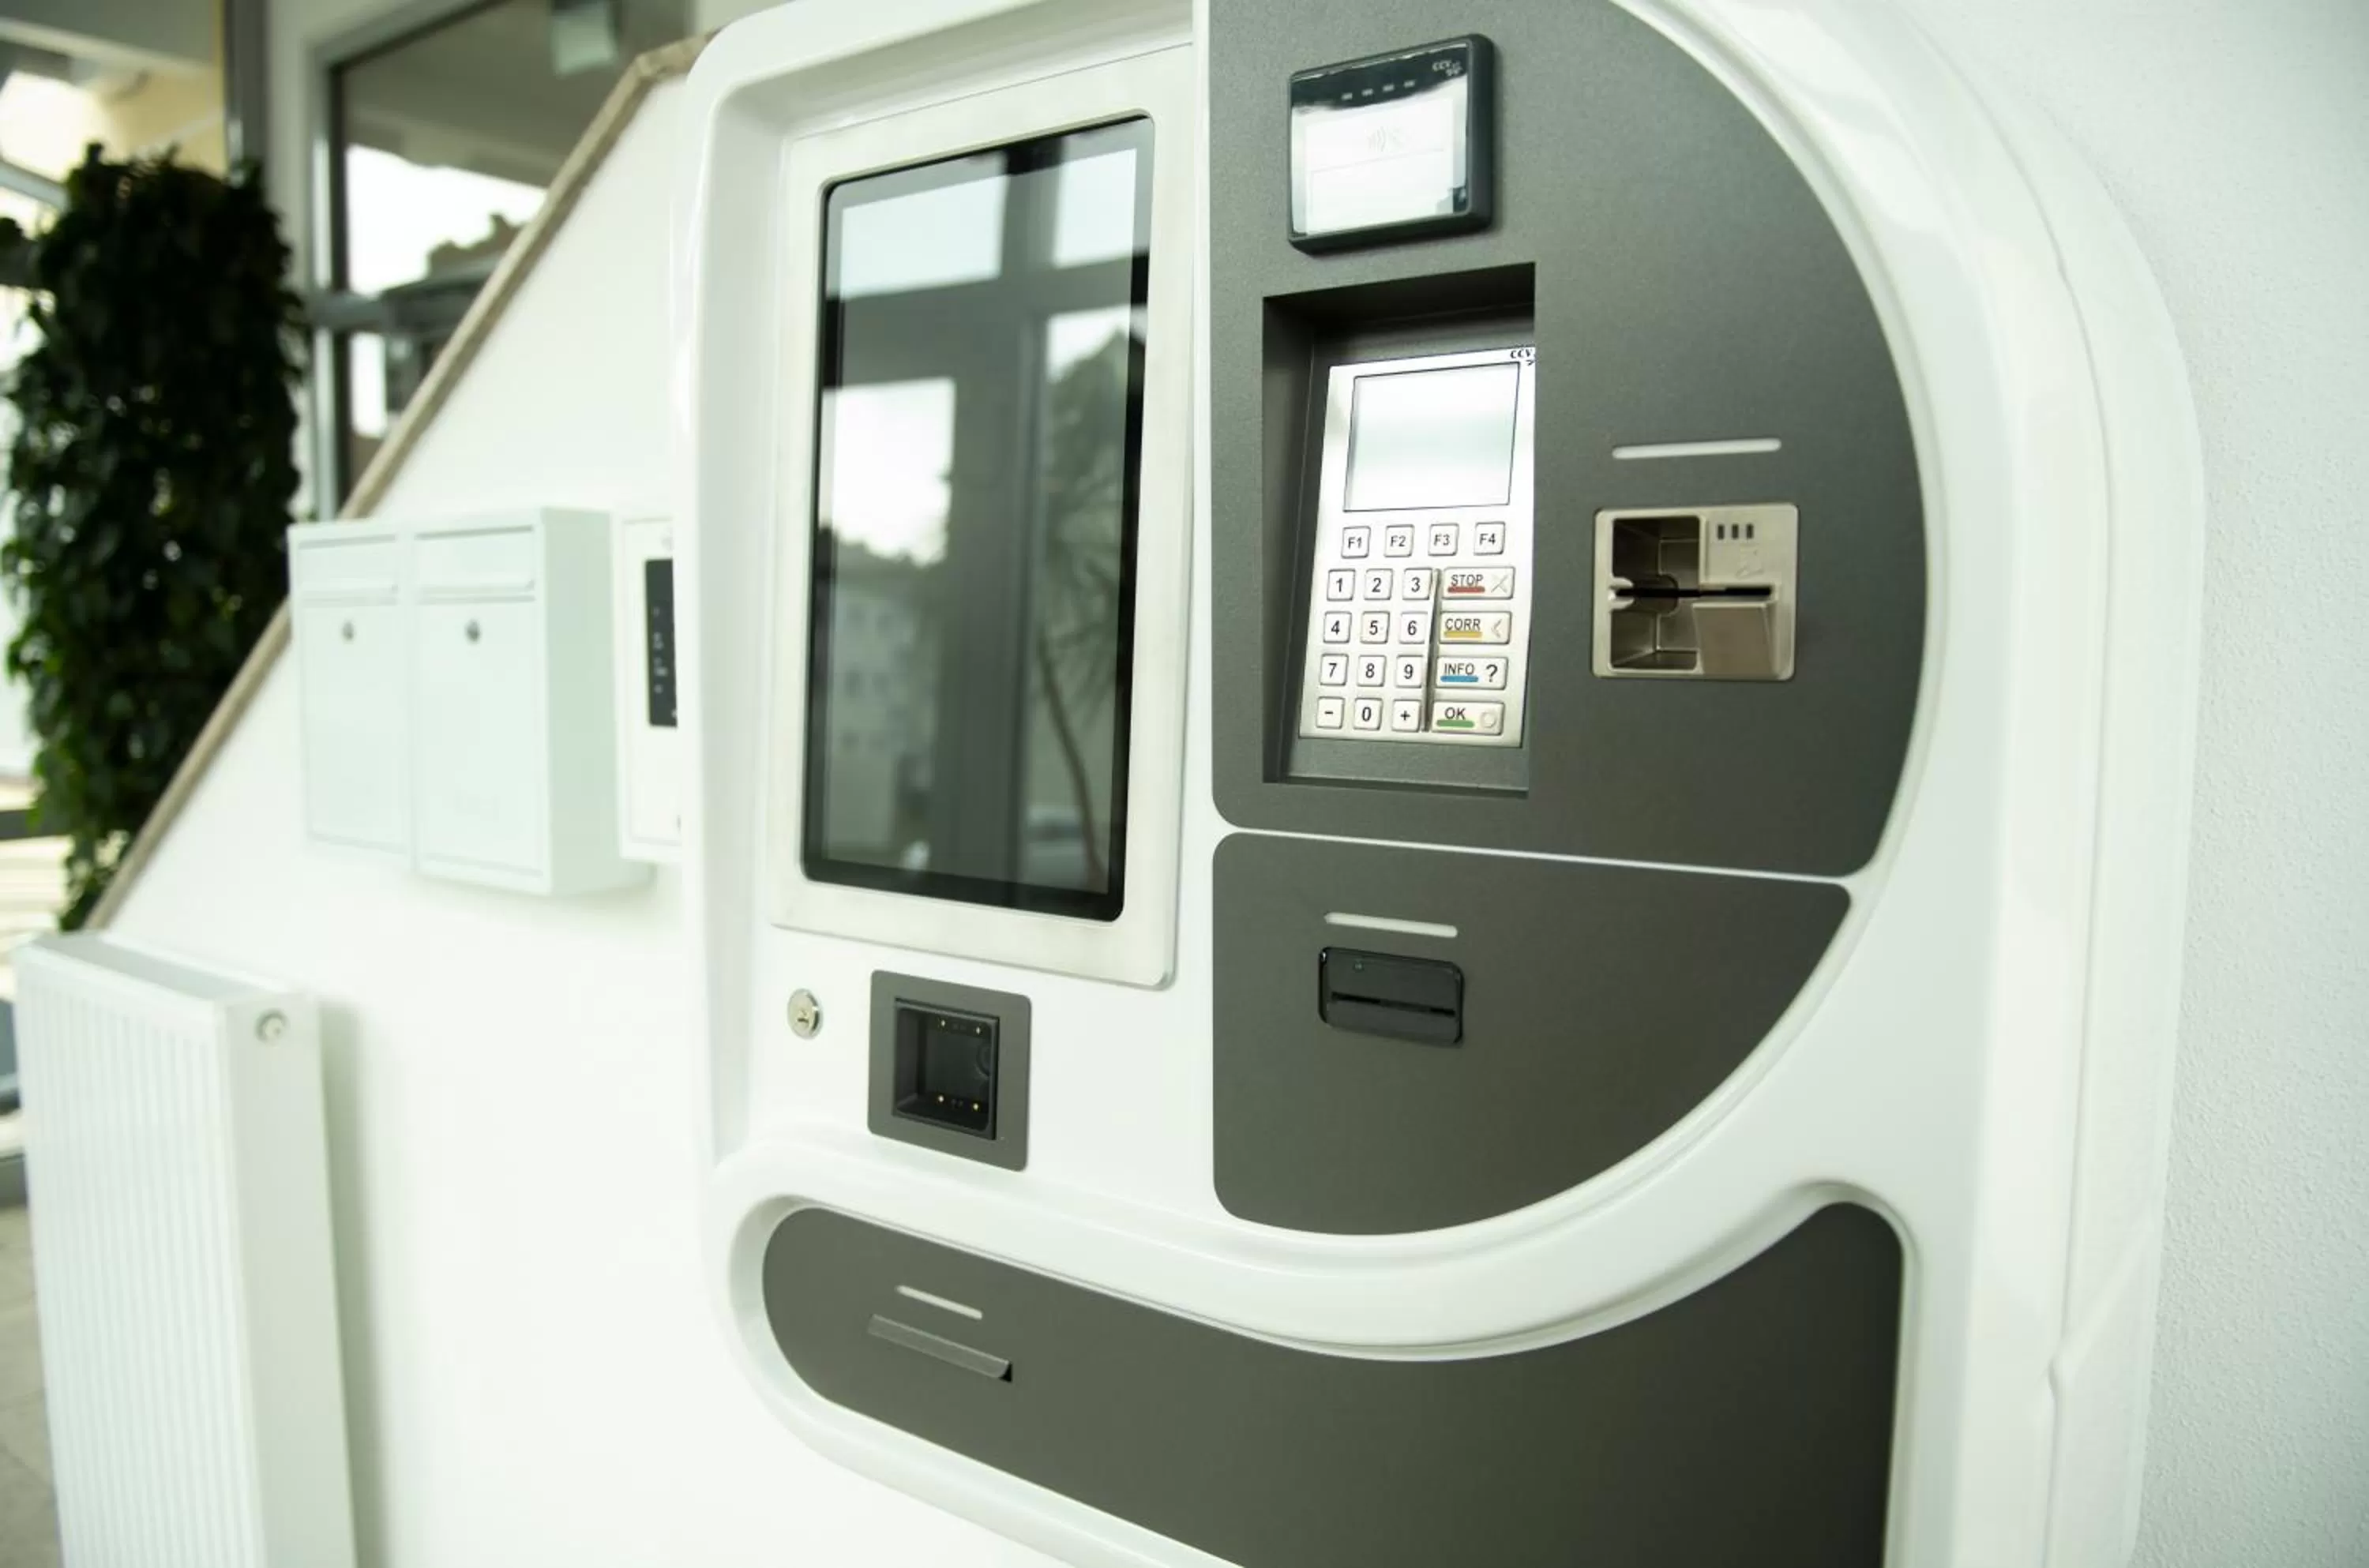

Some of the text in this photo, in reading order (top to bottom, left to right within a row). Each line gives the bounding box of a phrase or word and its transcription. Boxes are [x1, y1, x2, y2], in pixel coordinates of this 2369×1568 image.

[1510, 349, 1533, 358] CCV
[1347, 532, 1496, 549] F1 F2 F3 F4
[1335, 576, 1421, 593] 1 2 3
[1450, 574, 1484, 587] STOP
[1331, 620, 1417, 636] 4 5 6
[1444, 618, 1481, 631] CORR
[1328, 662, 1414, 680] 7 8 9
[1444, 663, 1498, 683] INFO ?
[1361, 707, 1372, 722] 0
[1444, 707, 1466, 719] OK
